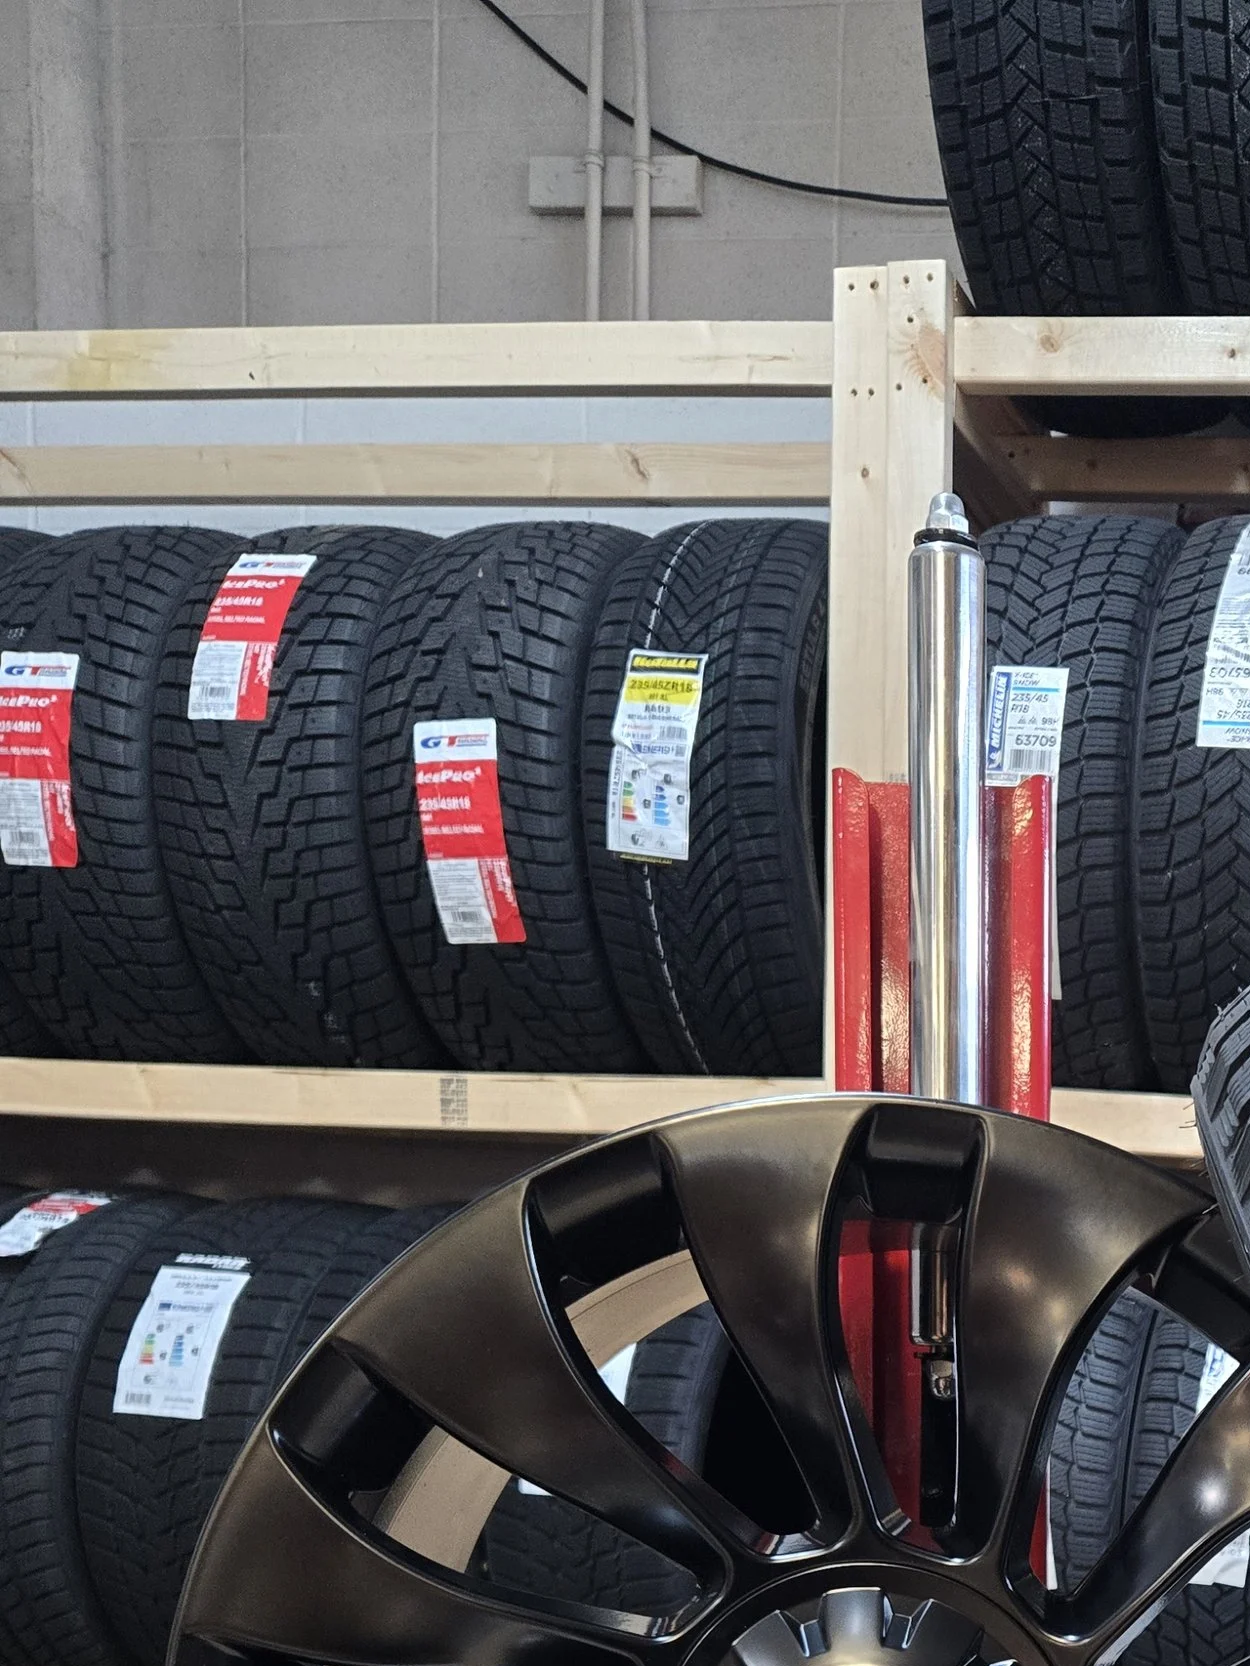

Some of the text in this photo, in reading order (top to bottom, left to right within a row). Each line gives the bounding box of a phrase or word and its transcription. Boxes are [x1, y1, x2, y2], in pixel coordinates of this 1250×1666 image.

[1011, 693, 1049, 704] 235/45
[991, 677, 1008, 748] MICHELIN
[1015, 734, 1057, 747] 63709
